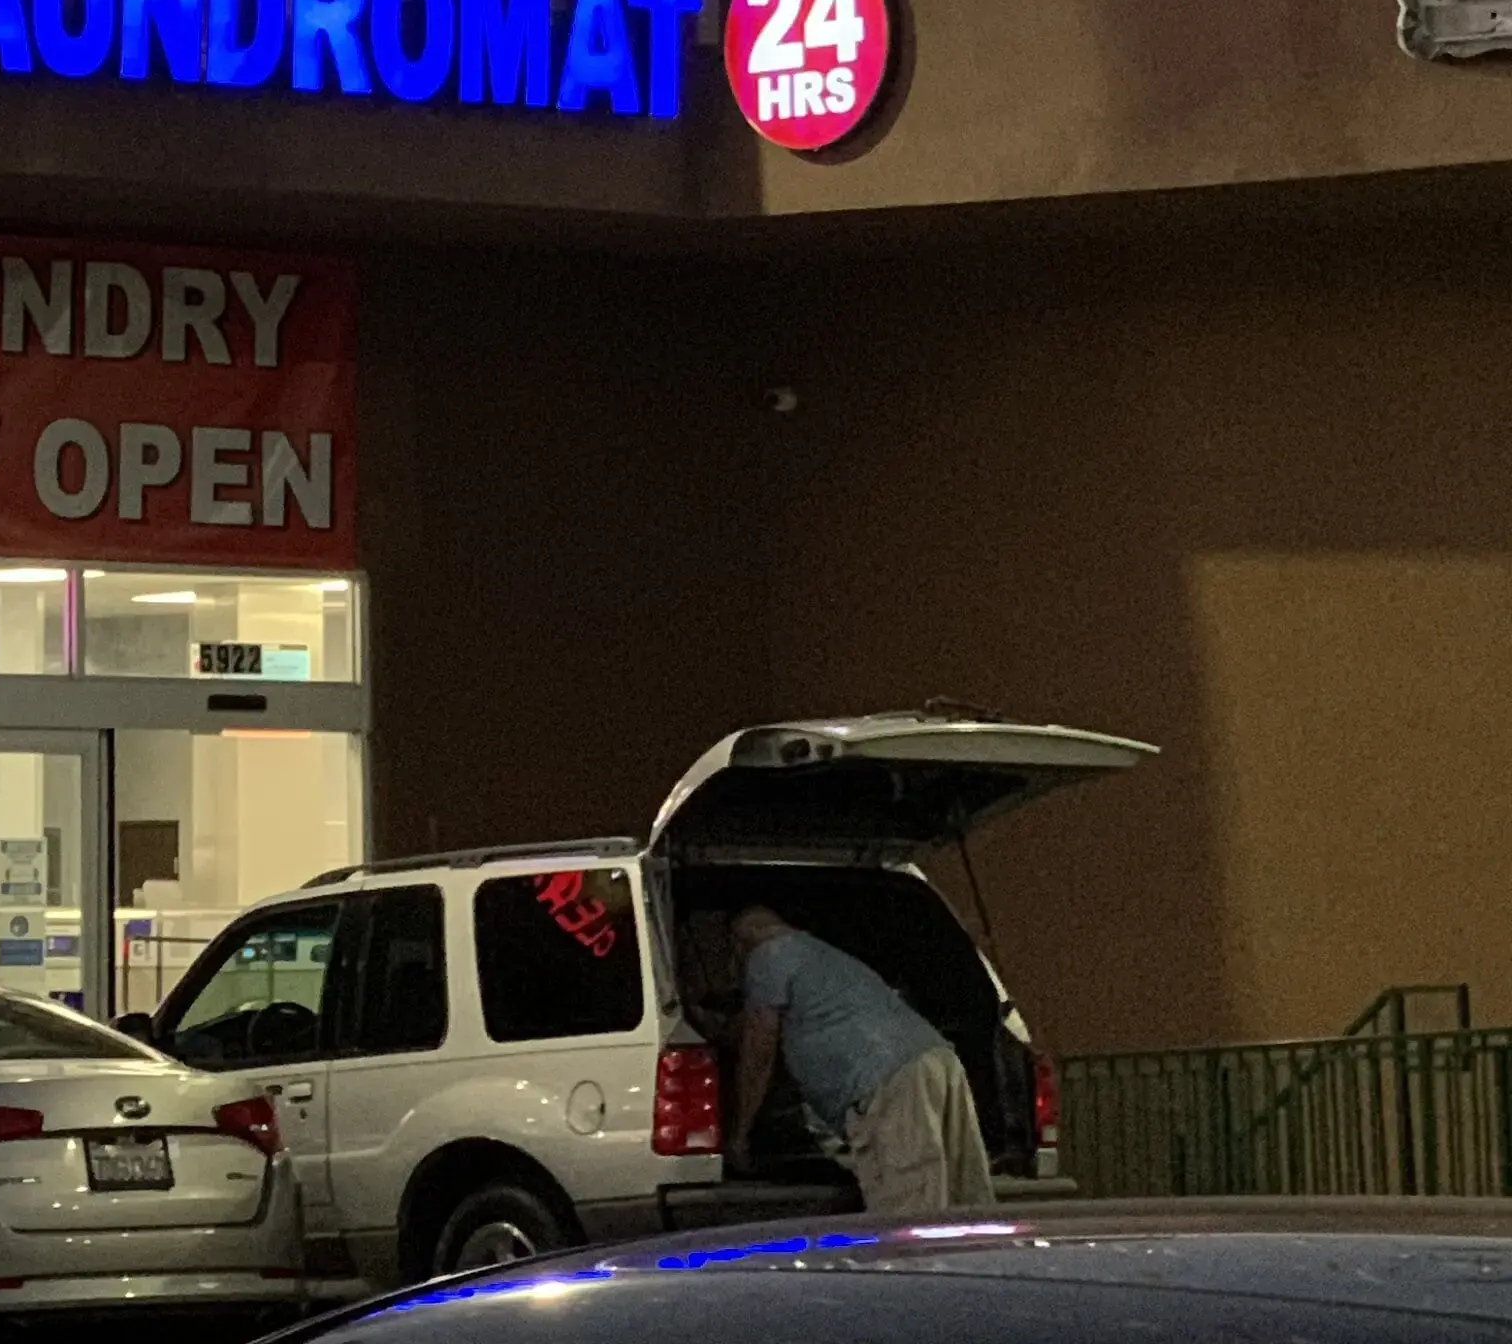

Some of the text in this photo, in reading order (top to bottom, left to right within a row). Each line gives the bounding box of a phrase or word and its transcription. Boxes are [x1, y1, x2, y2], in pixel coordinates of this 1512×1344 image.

[758, 67, 856, 122] HRS
[33, 418, 333, 529] OPEN
[199, 643, 262, 674] 5922
